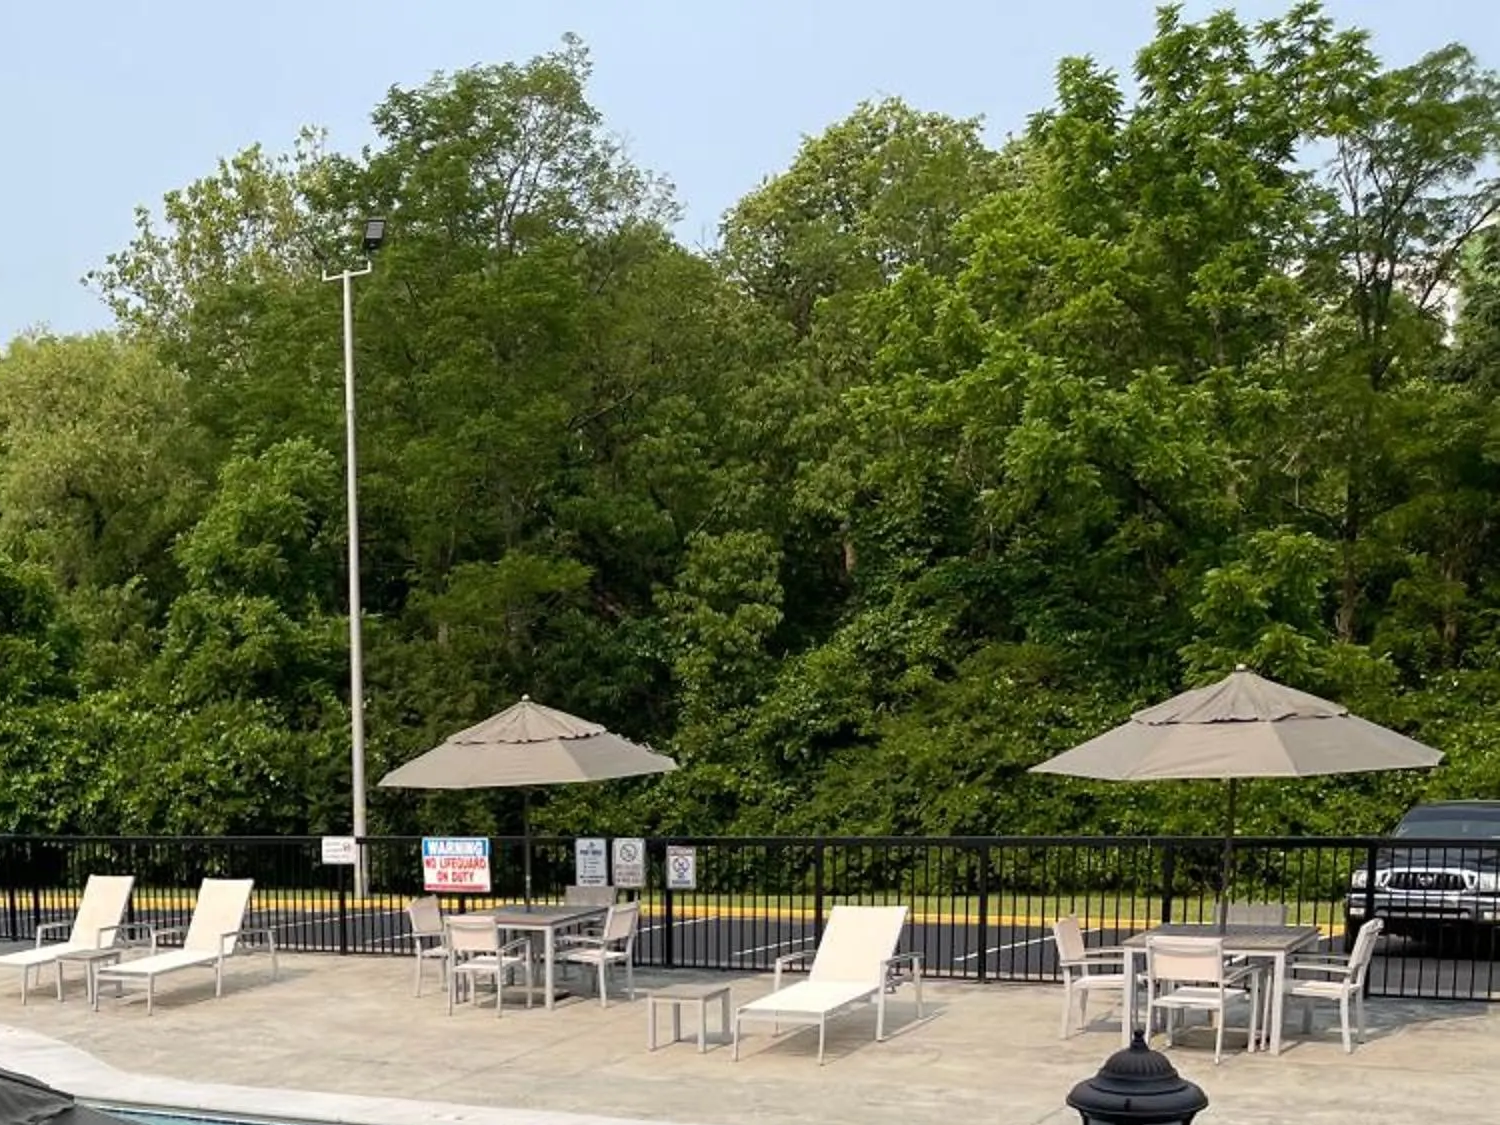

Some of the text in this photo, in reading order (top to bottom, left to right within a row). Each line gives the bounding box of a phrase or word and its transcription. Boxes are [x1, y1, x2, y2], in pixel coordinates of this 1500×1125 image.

[425, 857, 486, 870] NO LIFEGUARD
[436, 870, 475, 882] ON DUTY
